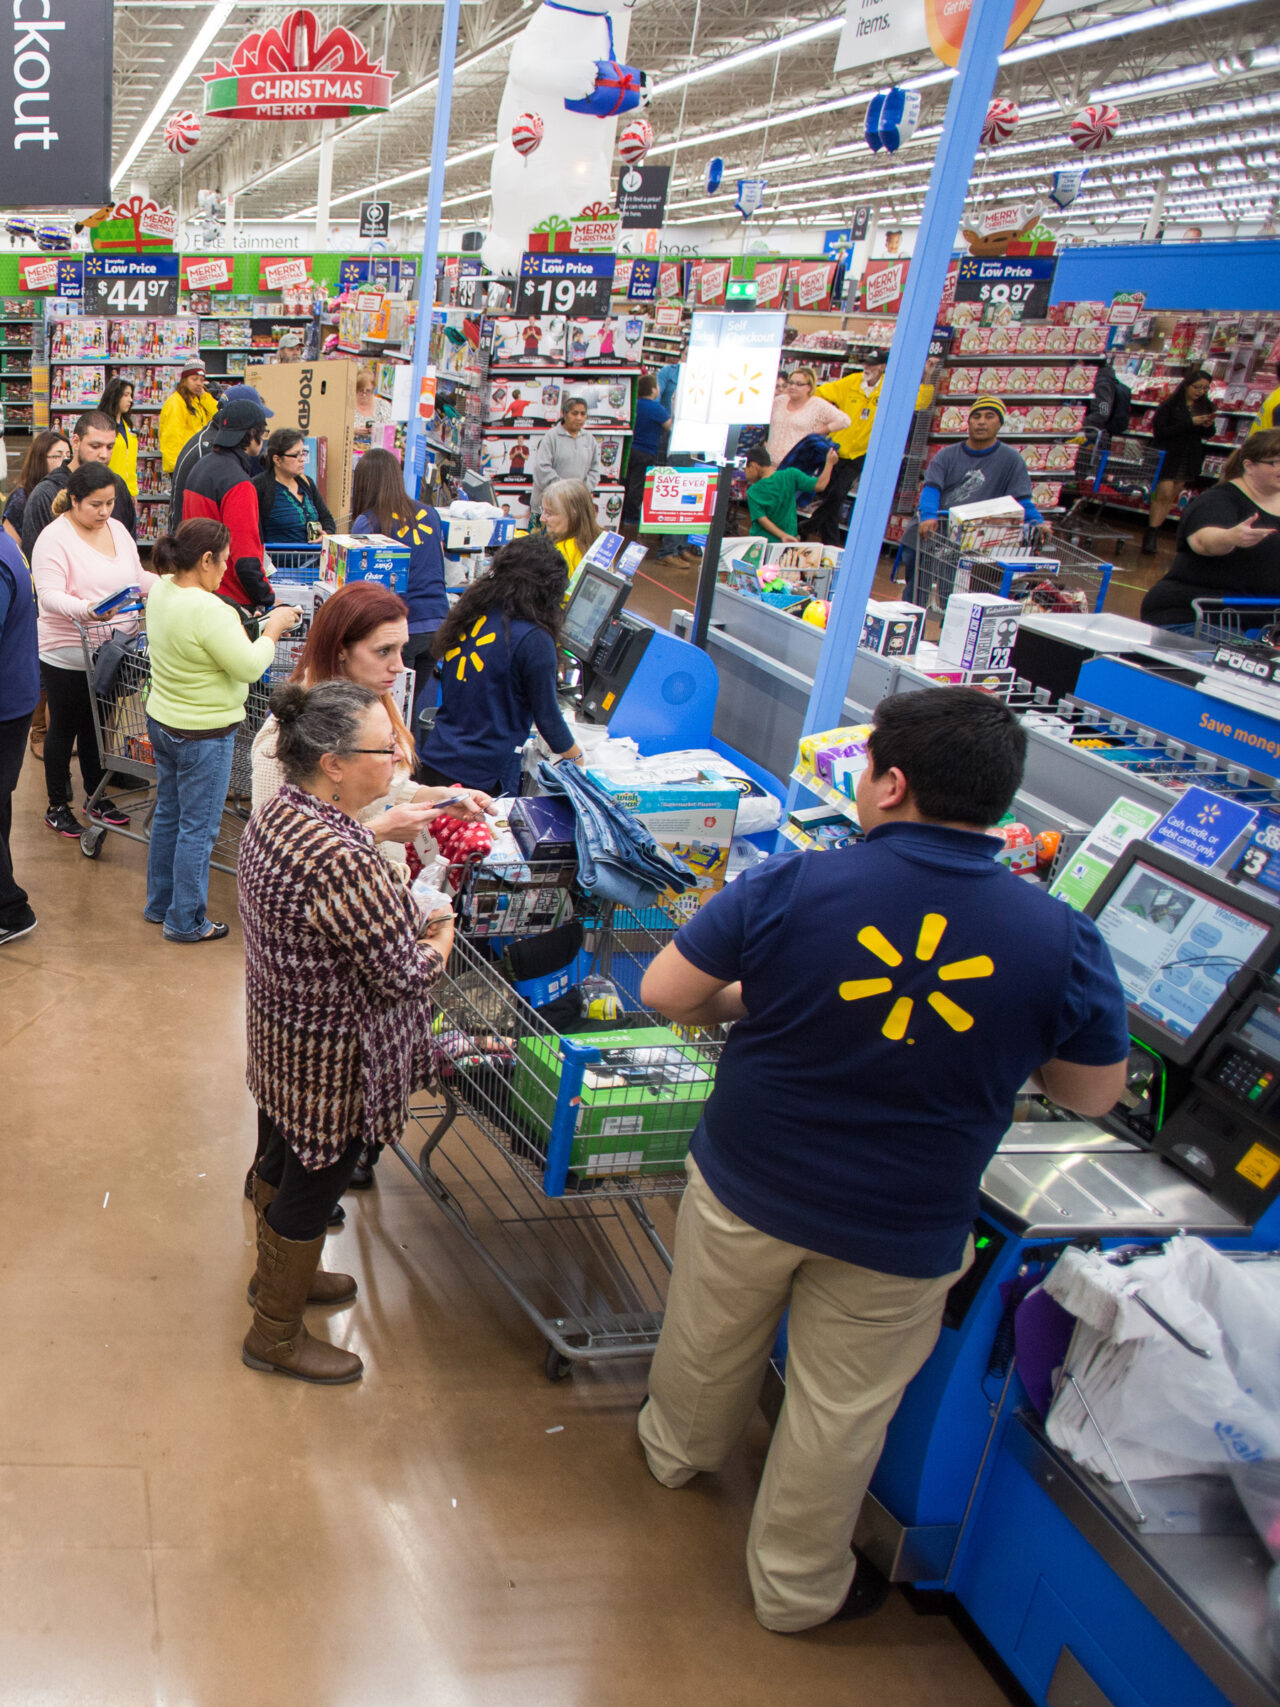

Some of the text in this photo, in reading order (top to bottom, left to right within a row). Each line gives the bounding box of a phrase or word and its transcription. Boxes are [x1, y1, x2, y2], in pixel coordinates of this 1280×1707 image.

[856, 15, 892, 38] items.
[251, 79, 364, 101] CHRISTMAS
[256, 104, 318, 117] MERRY
[143, 213, 176, 226] MERRY
[985, 209, 1018, 223] MERRY
[143, 222, 175, 235] CHRISTMAS
[575, 223, 618, 237] MERRY
[985, 218, 1018, 229] CHRISTMAS
[574, 234, 616, 244] CHRISTMAS
[104, 263, 157, 274] Low Price
[189, 263, 223, 277] MERRY
[268, 263, 302, 277] MERRY
[542, 262, 594, 274] Low Price
[979, 266, 1033, 278] Low Price
[191, 271, 225, 285] CHRISTMAS
[269, 271, 304, 285] CHRISTMAS
[703, 270, 724, 287] MERRY
[800, 271, 825, 290] MERRY
[869, 269, 900, 289] MERRY
[61, 287, 79, 295] Low
[632, 287, 651, 296] Low
[869, 283, 899, 301] CHRISTMAS
[727, 320, 748, 331] Self
[727, 330, 775, 343] Checkout
[657, 475, 705, 488] SAVE EVER
[656, 485, 680, 498] $35
[364, 572, 384, 582] Oster
[990, 647, 1012, 669] 23
[1214, 651, 1270, 677] POGO
[1199, 712, 1280, 760] Save money
[1167, 815, 1185, 831] Cash,
[1185, 824, 1209, 841] credit,
[1158, 826, 1217, 858] debit cards only.
[1243, 849, 1269, 876] $3
[1215, 907, 1252, 931] Walmart
